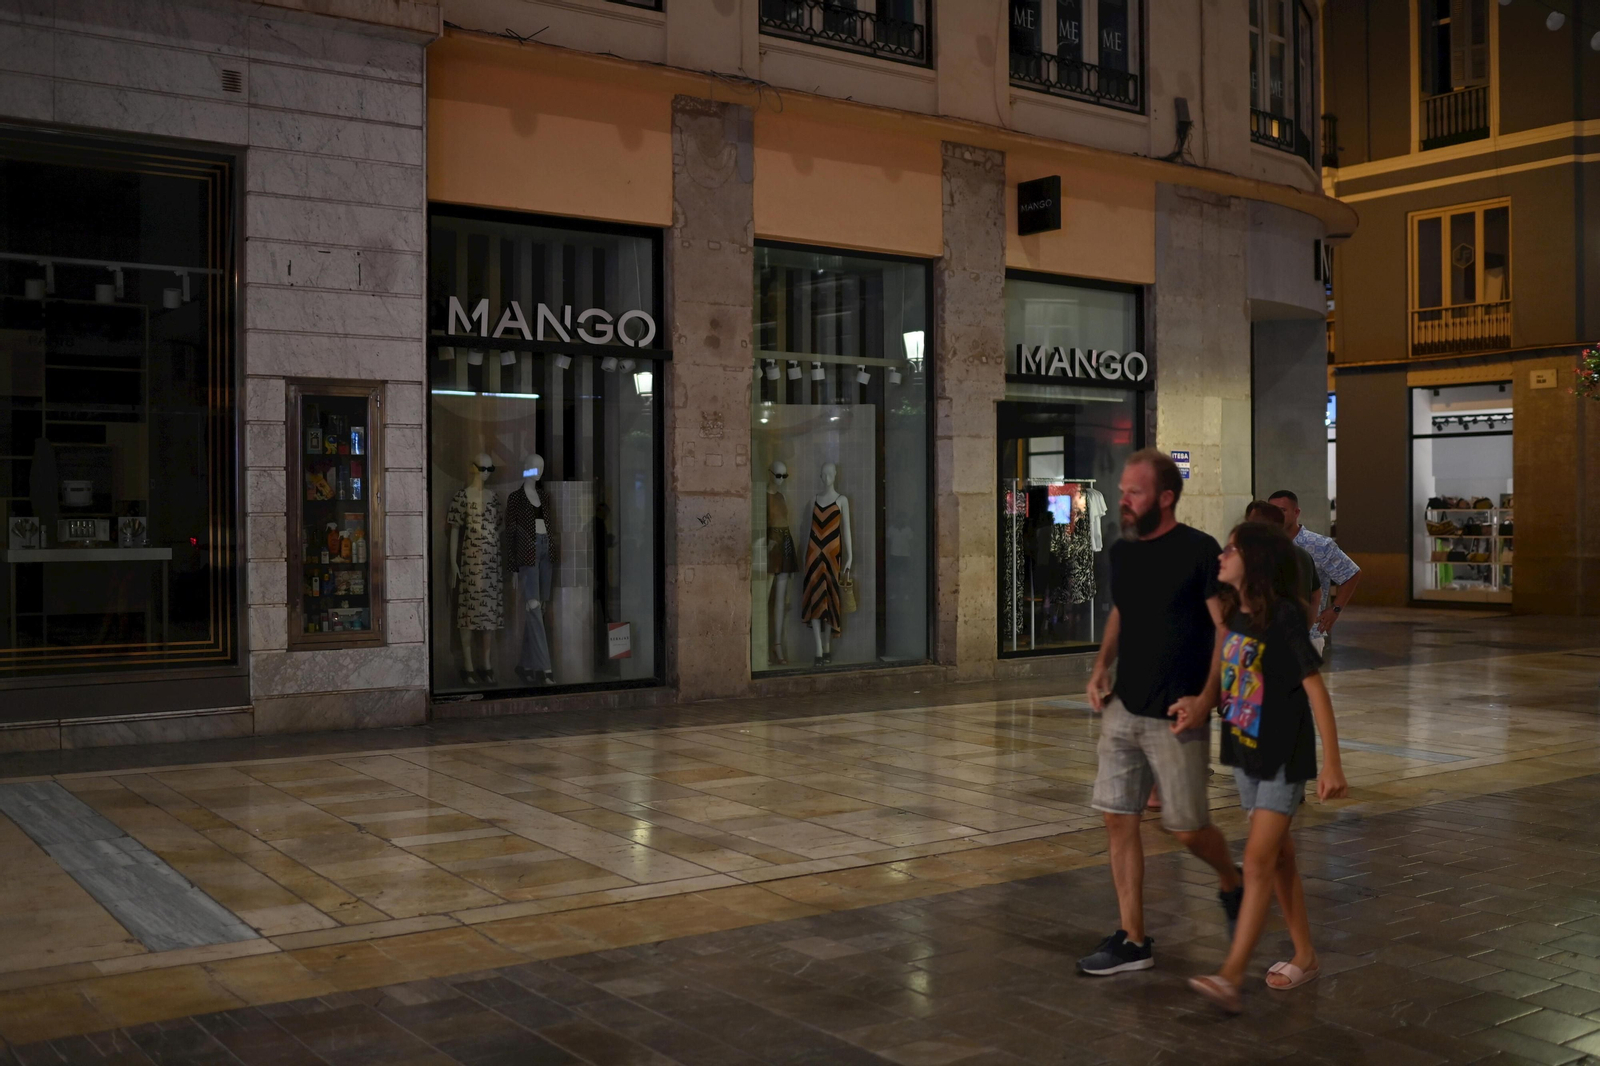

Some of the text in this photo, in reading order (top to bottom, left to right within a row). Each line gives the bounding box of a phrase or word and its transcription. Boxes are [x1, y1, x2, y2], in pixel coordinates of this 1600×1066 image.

[1013, 5, 1035, 30] ME
[1059, 18, 1079, 40] ME
[1102, 29, 1122, 52] ME
[1020, 199, 1053, 213] MANGO
[448, 296, 656, 347] MANGO
[1018, 343, 1149, 382] MANGO
